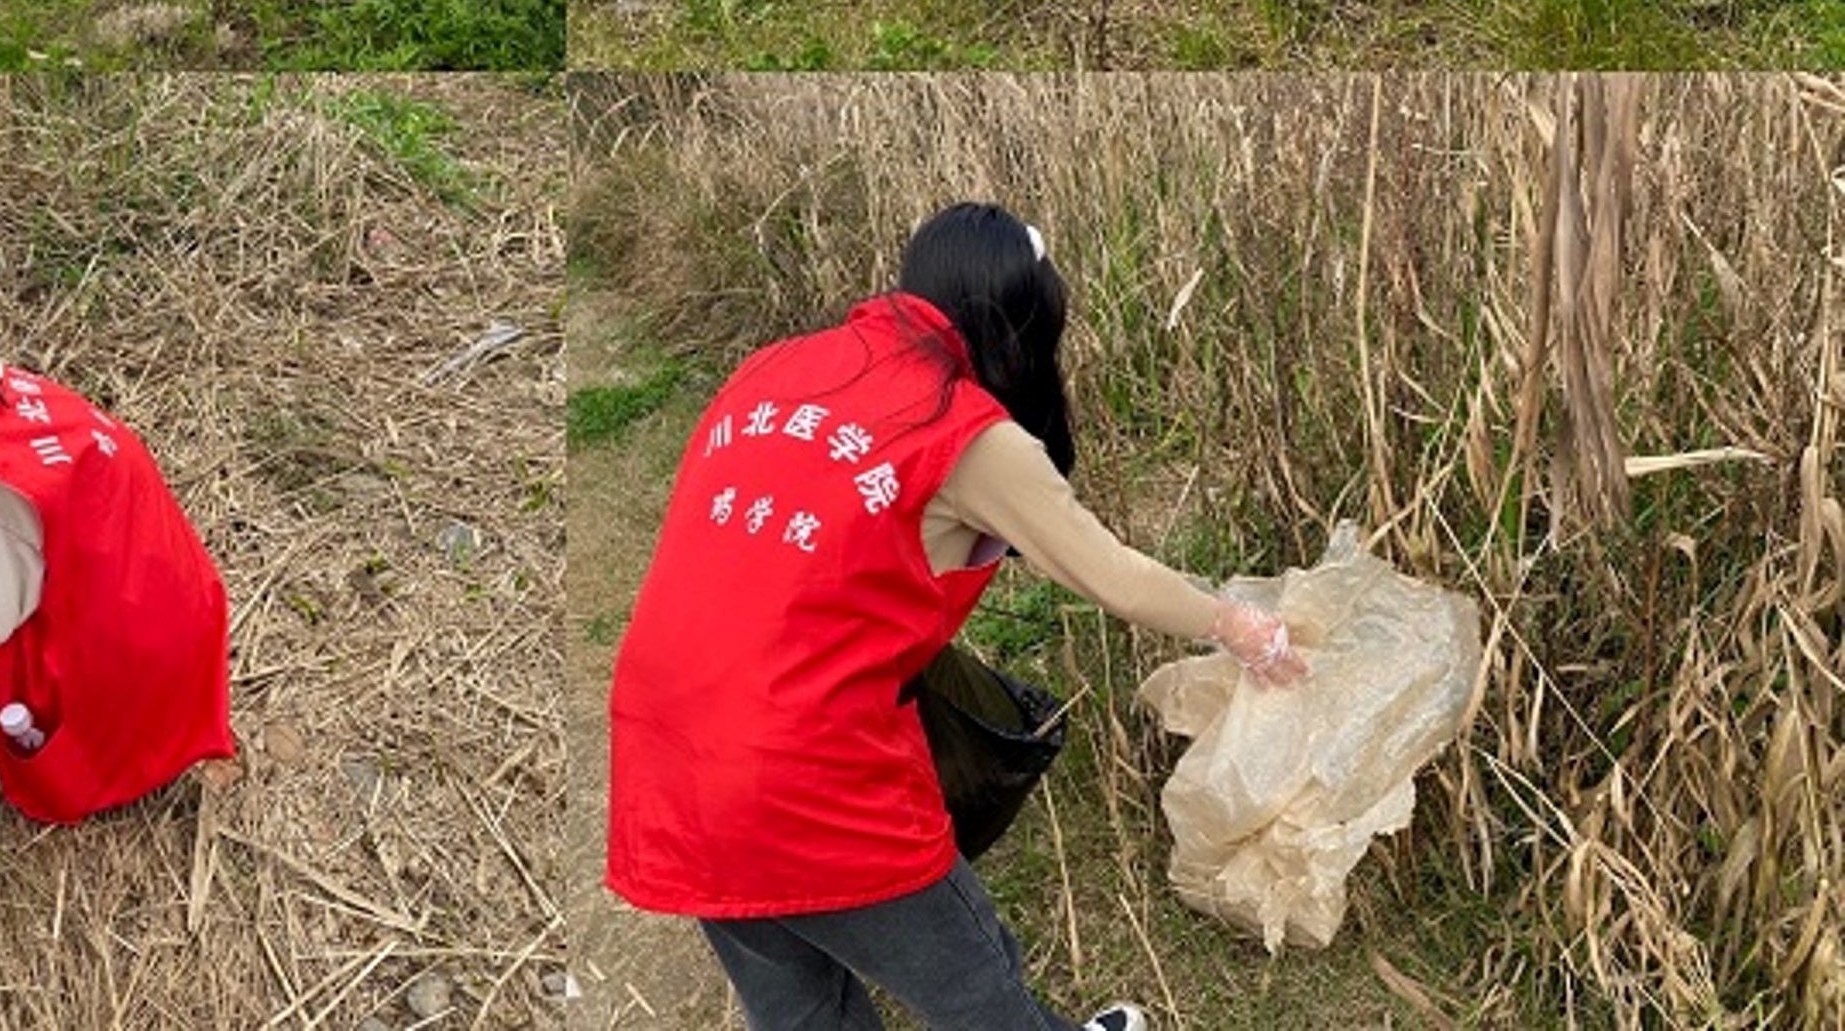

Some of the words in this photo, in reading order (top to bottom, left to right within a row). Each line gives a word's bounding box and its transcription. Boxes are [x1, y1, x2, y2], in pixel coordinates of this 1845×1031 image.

[704, 401, 900, 514] 川北医学院
